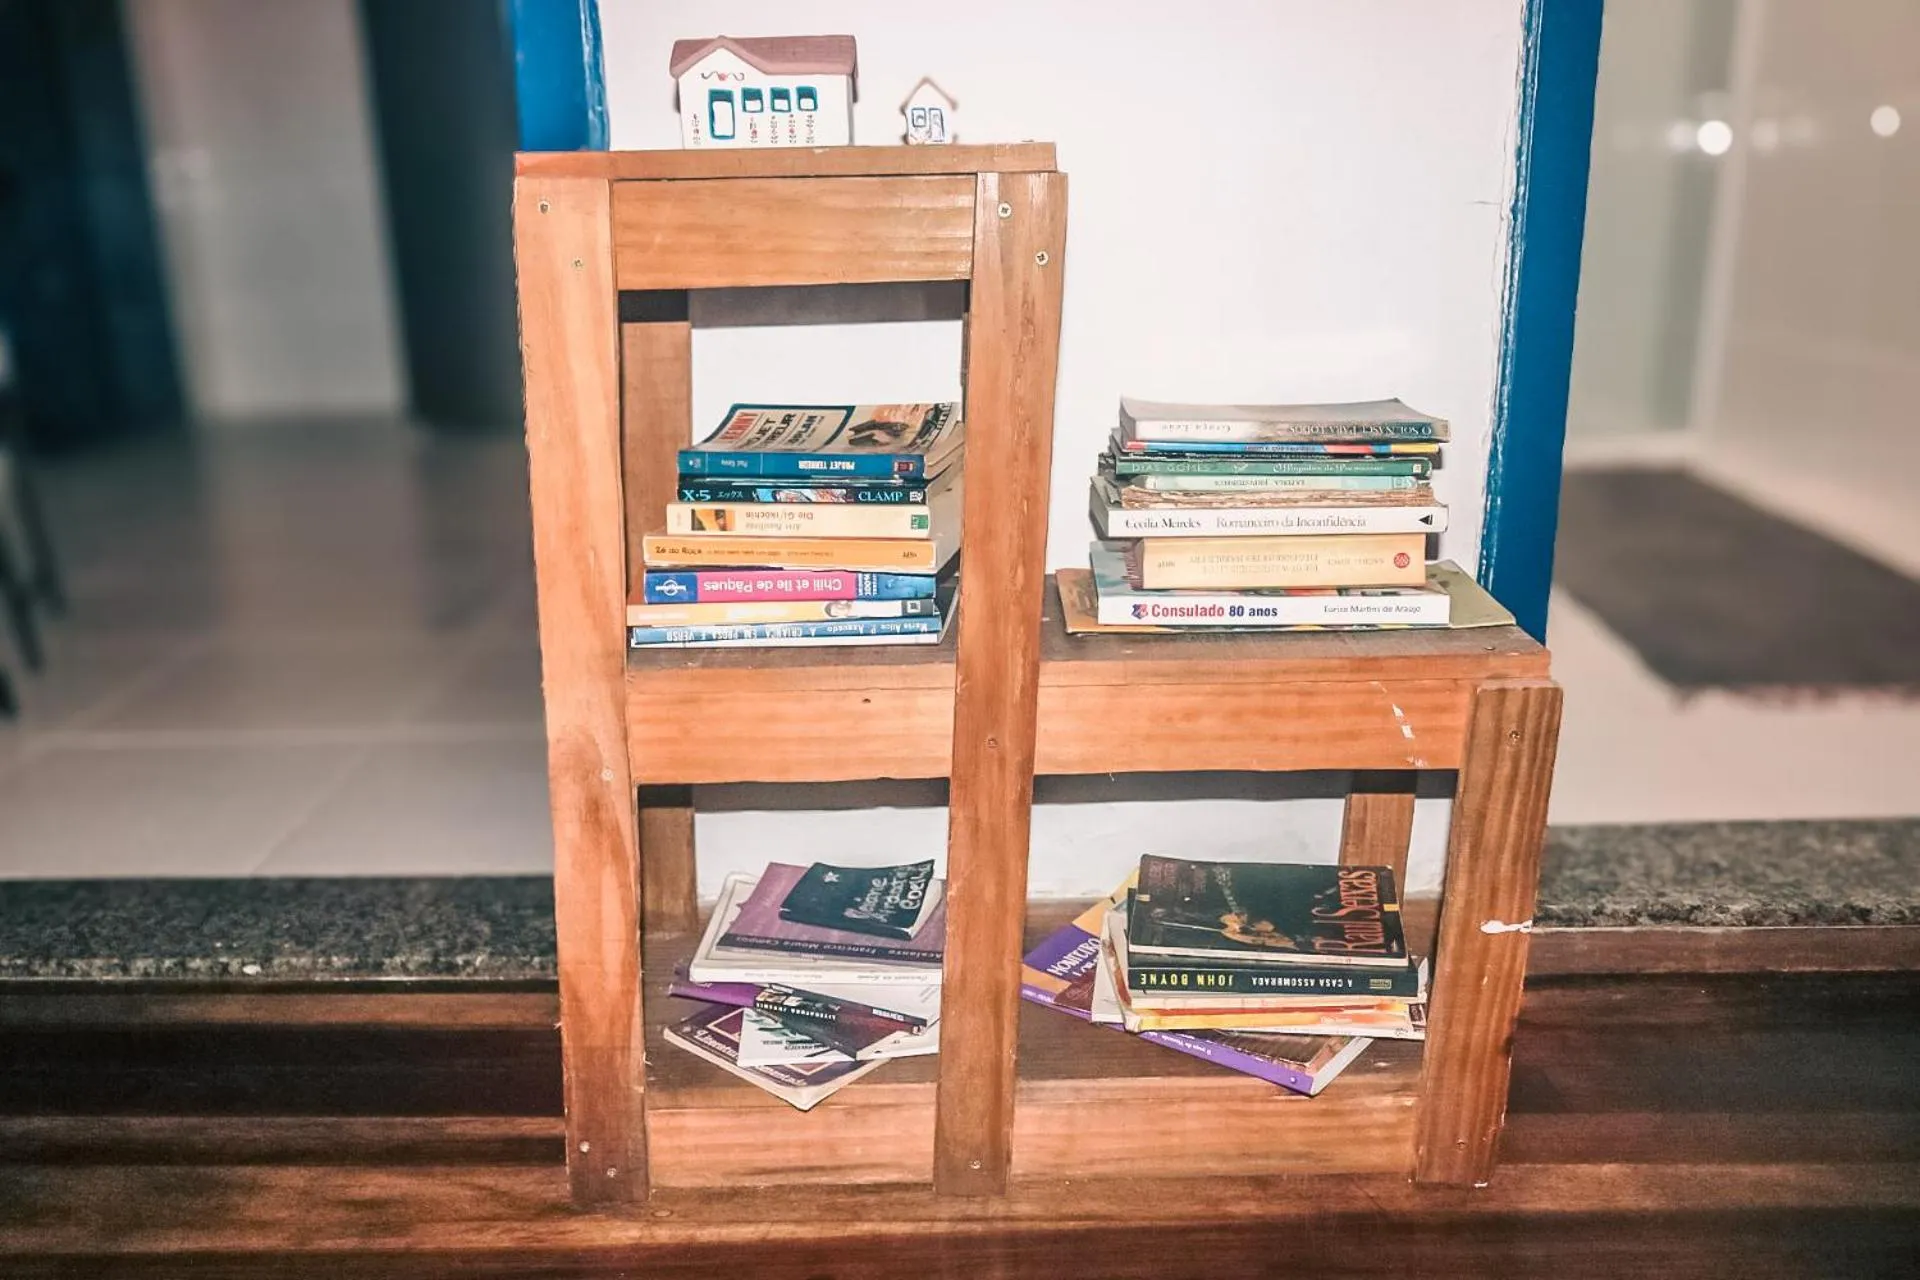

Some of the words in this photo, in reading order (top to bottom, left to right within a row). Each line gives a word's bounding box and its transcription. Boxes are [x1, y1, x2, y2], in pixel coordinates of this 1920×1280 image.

[858, 490, 903, 501] CLAMP
[1281, 516, 1294, 528] da
[756, 580, 774, 592] de
[796, 579, 810, 591] et
[813, 577, 842, 591] Chili
[1151, 603, 1225, 618] Consulado
[1228, 605, 1245, 617] 80
[1249, 607, 1278, 617] anos
[666, 631, 694, 642] VERSO
[1139, 973, 1188, 985] BOYNE
[1196, 974, 1233, 986] JOHN
[1251, 976, 1315, 987] ASSOMBRADA
[1317, 977, 1344, 988] CASA
[1346, 978, 1353, 988] A
